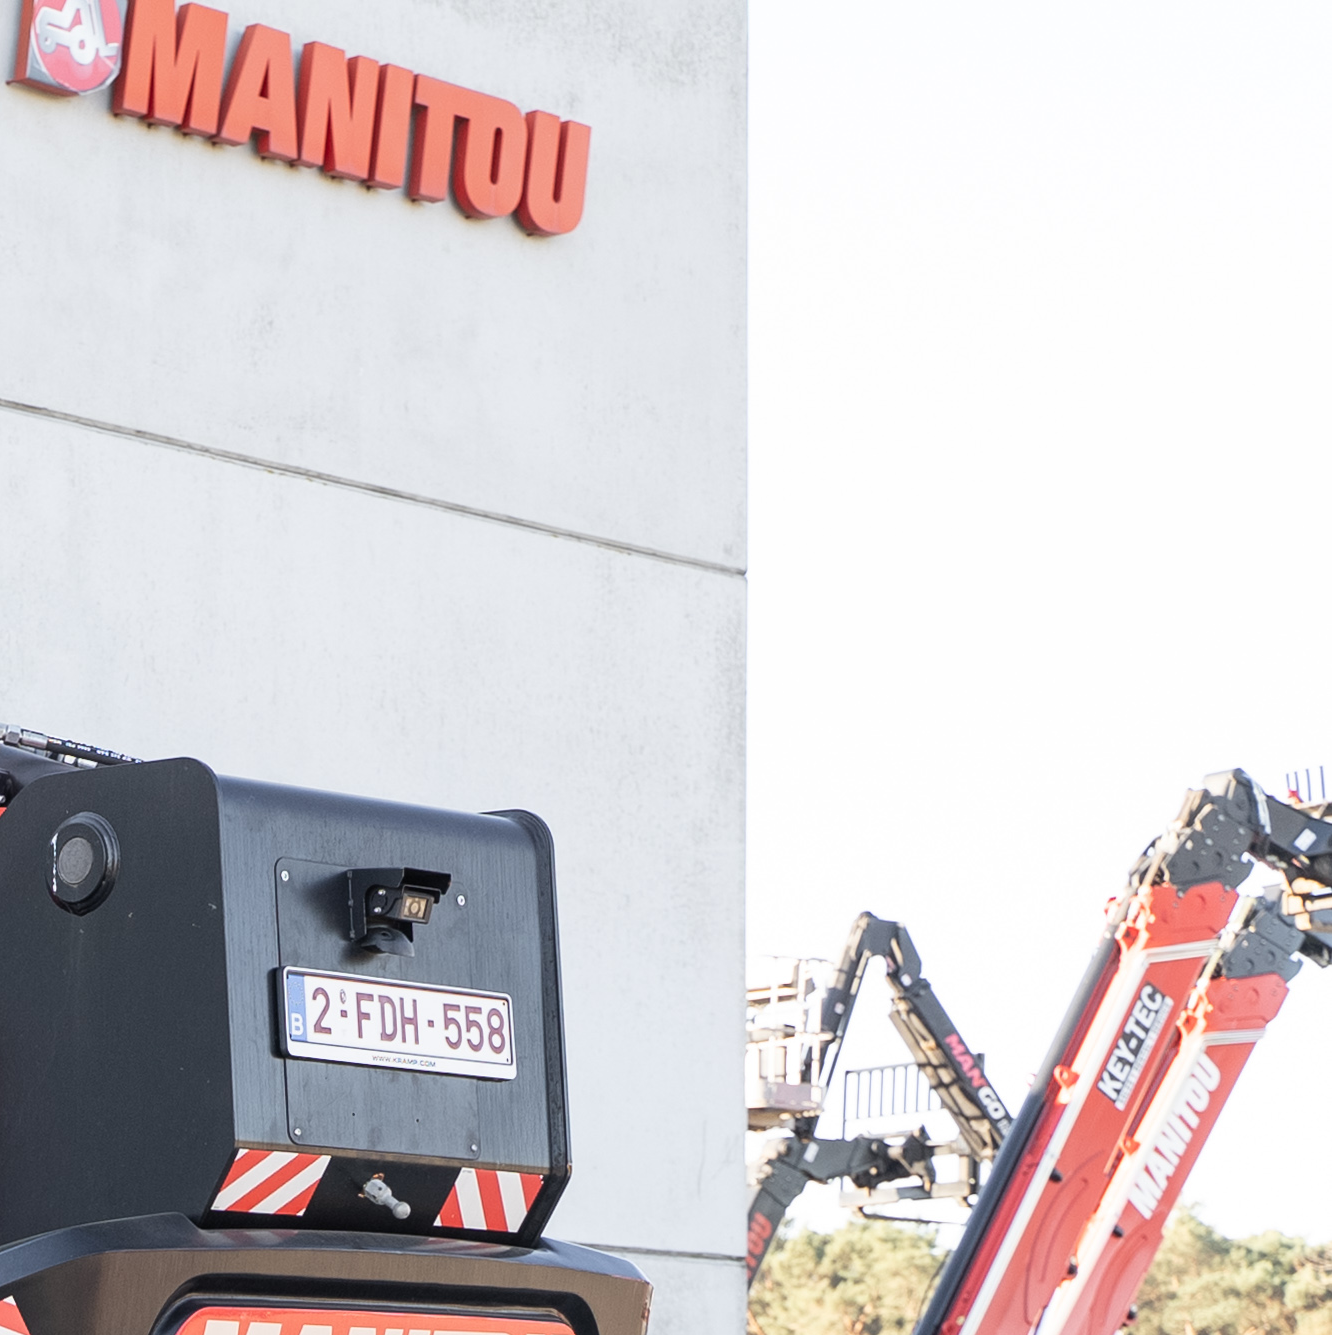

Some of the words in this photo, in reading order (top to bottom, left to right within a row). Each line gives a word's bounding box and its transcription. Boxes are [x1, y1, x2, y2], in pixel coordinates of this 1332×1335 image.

[112, 0, 592, 237] MANITOU
[291, 1014, 305, 1036] B
[1097, 984, 1163, 1101] KEY-TEC
[1128, 1051, 1221, 1221] MANITOU
